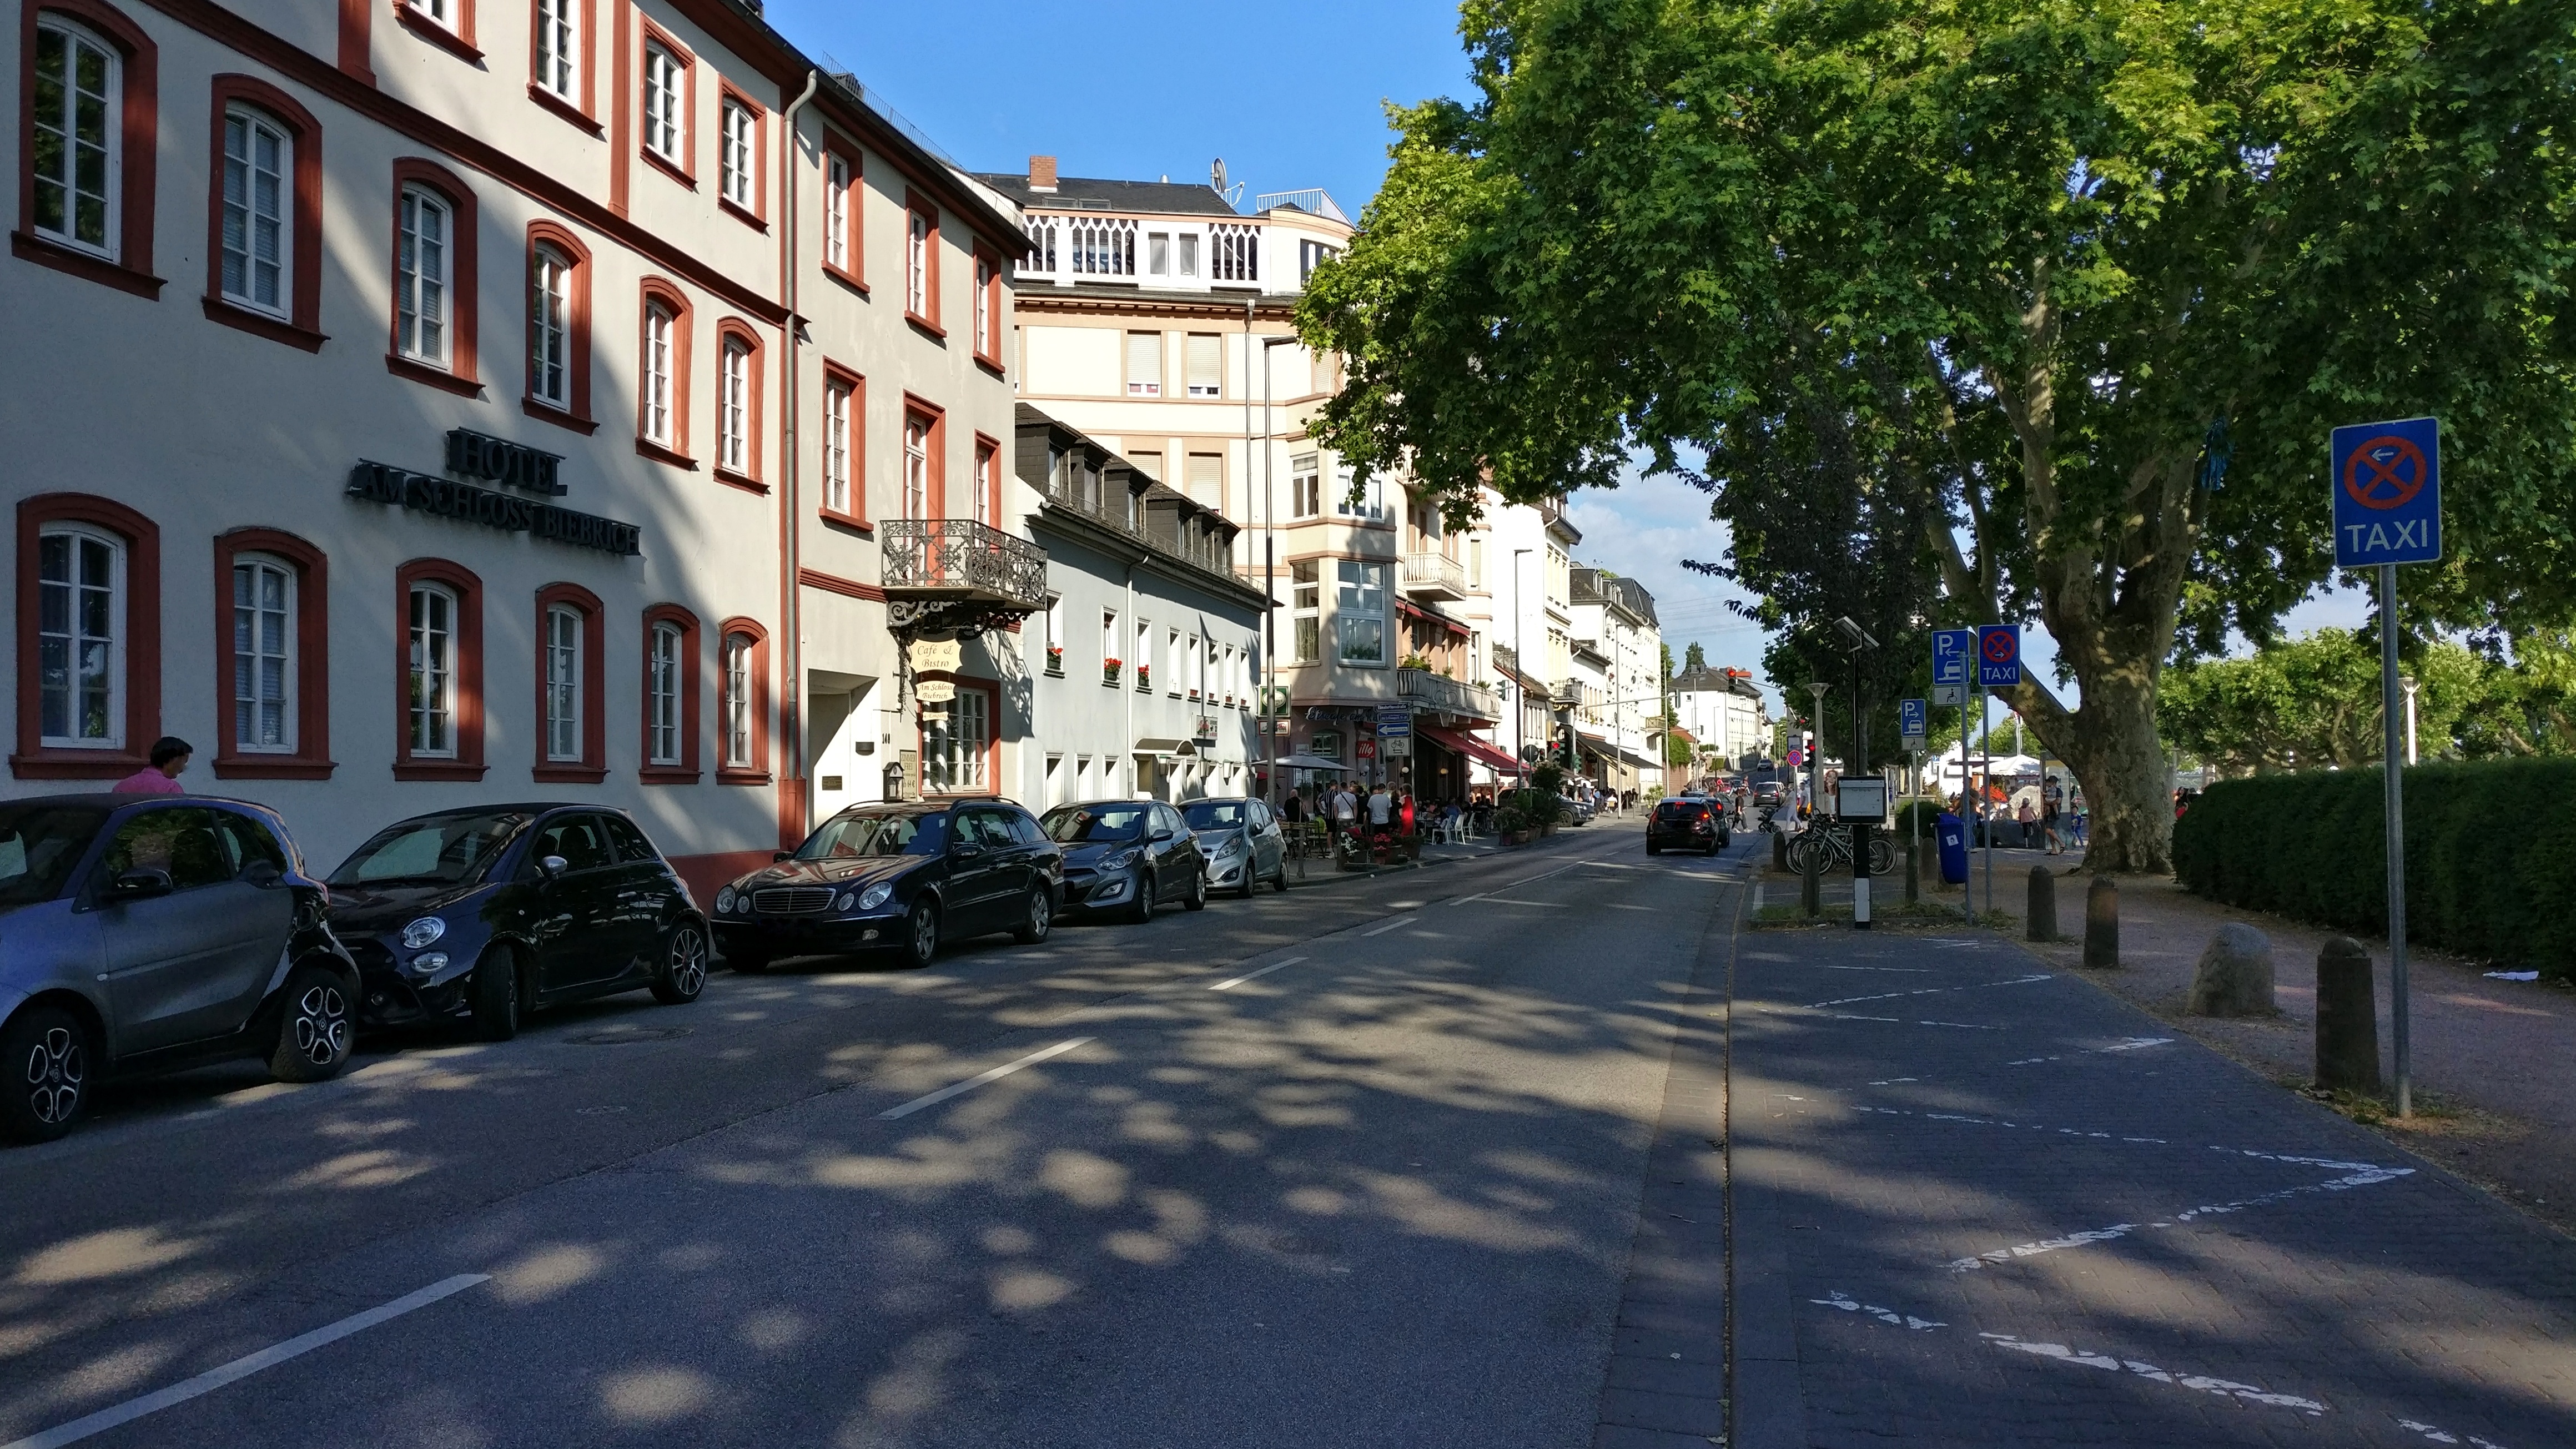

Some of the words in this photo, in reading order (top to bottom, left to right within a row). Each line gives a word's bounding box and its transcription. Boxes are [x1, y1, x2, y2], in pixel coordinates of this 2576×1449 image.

[446, 430, 567, 496] HOTEL
[349, 462, 405, 504] AM
[406, 476, 534, 531] SCHLOSS
[531, 504, 641, 555] BIEBRICH
[2344, 519, 2428, 553] TAXI
[917, 644, 938, 657] Café
[943, 645, 953, 655] &
[1938, 635, 1953, 656] P
[922, 658, 949, 668] Bistro
[1983, 667, 2016, 681] TAXI
[930, 683, 953, 691] Schloss
[1905, 703, 1916, 717] P
[1358, 743, 1373, 757] illy
